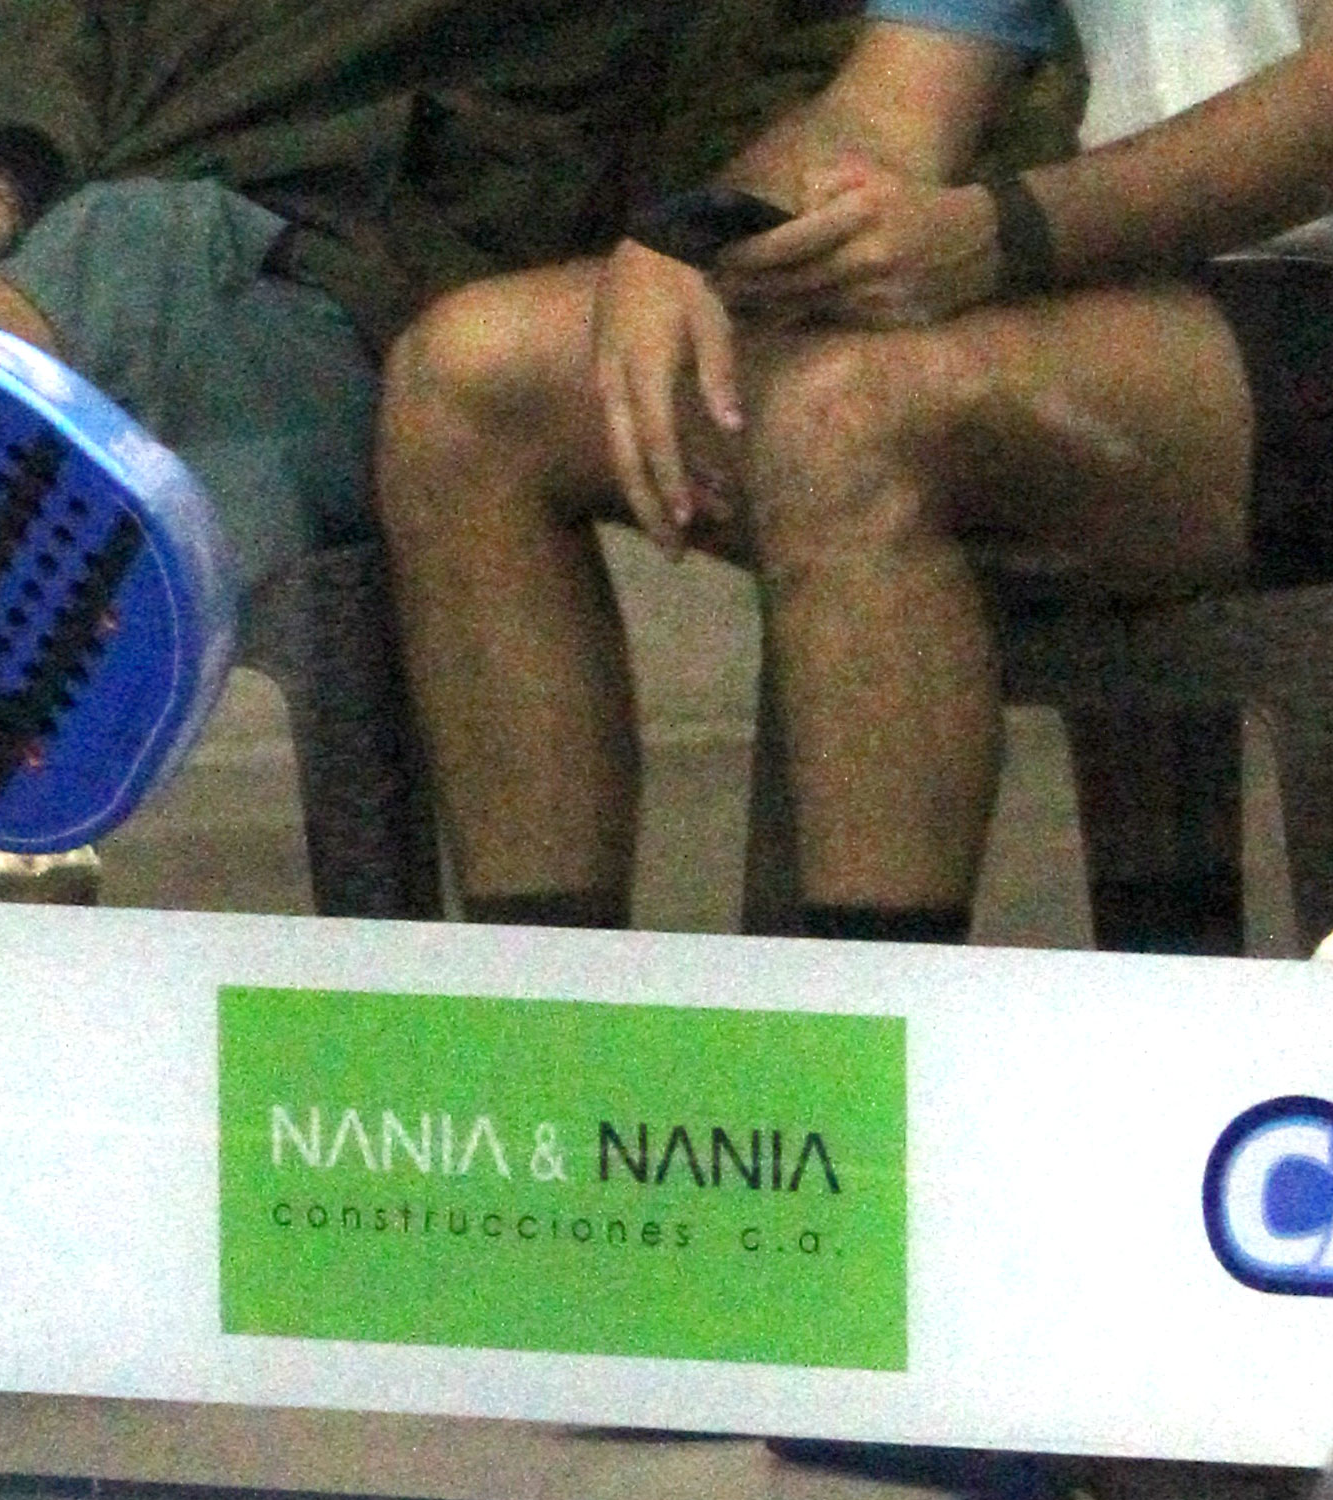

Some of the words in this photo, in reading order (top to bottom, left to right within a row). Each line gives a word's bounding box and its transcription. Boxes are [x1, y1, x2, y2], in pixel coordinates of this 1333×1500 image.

[272, 1104, 511, 1179] NANIA
[531, 1121, 568, 1181] &
[599, 1120, 842, 1194] NANIA
[272, 1200, 691, 1247] construcciones
